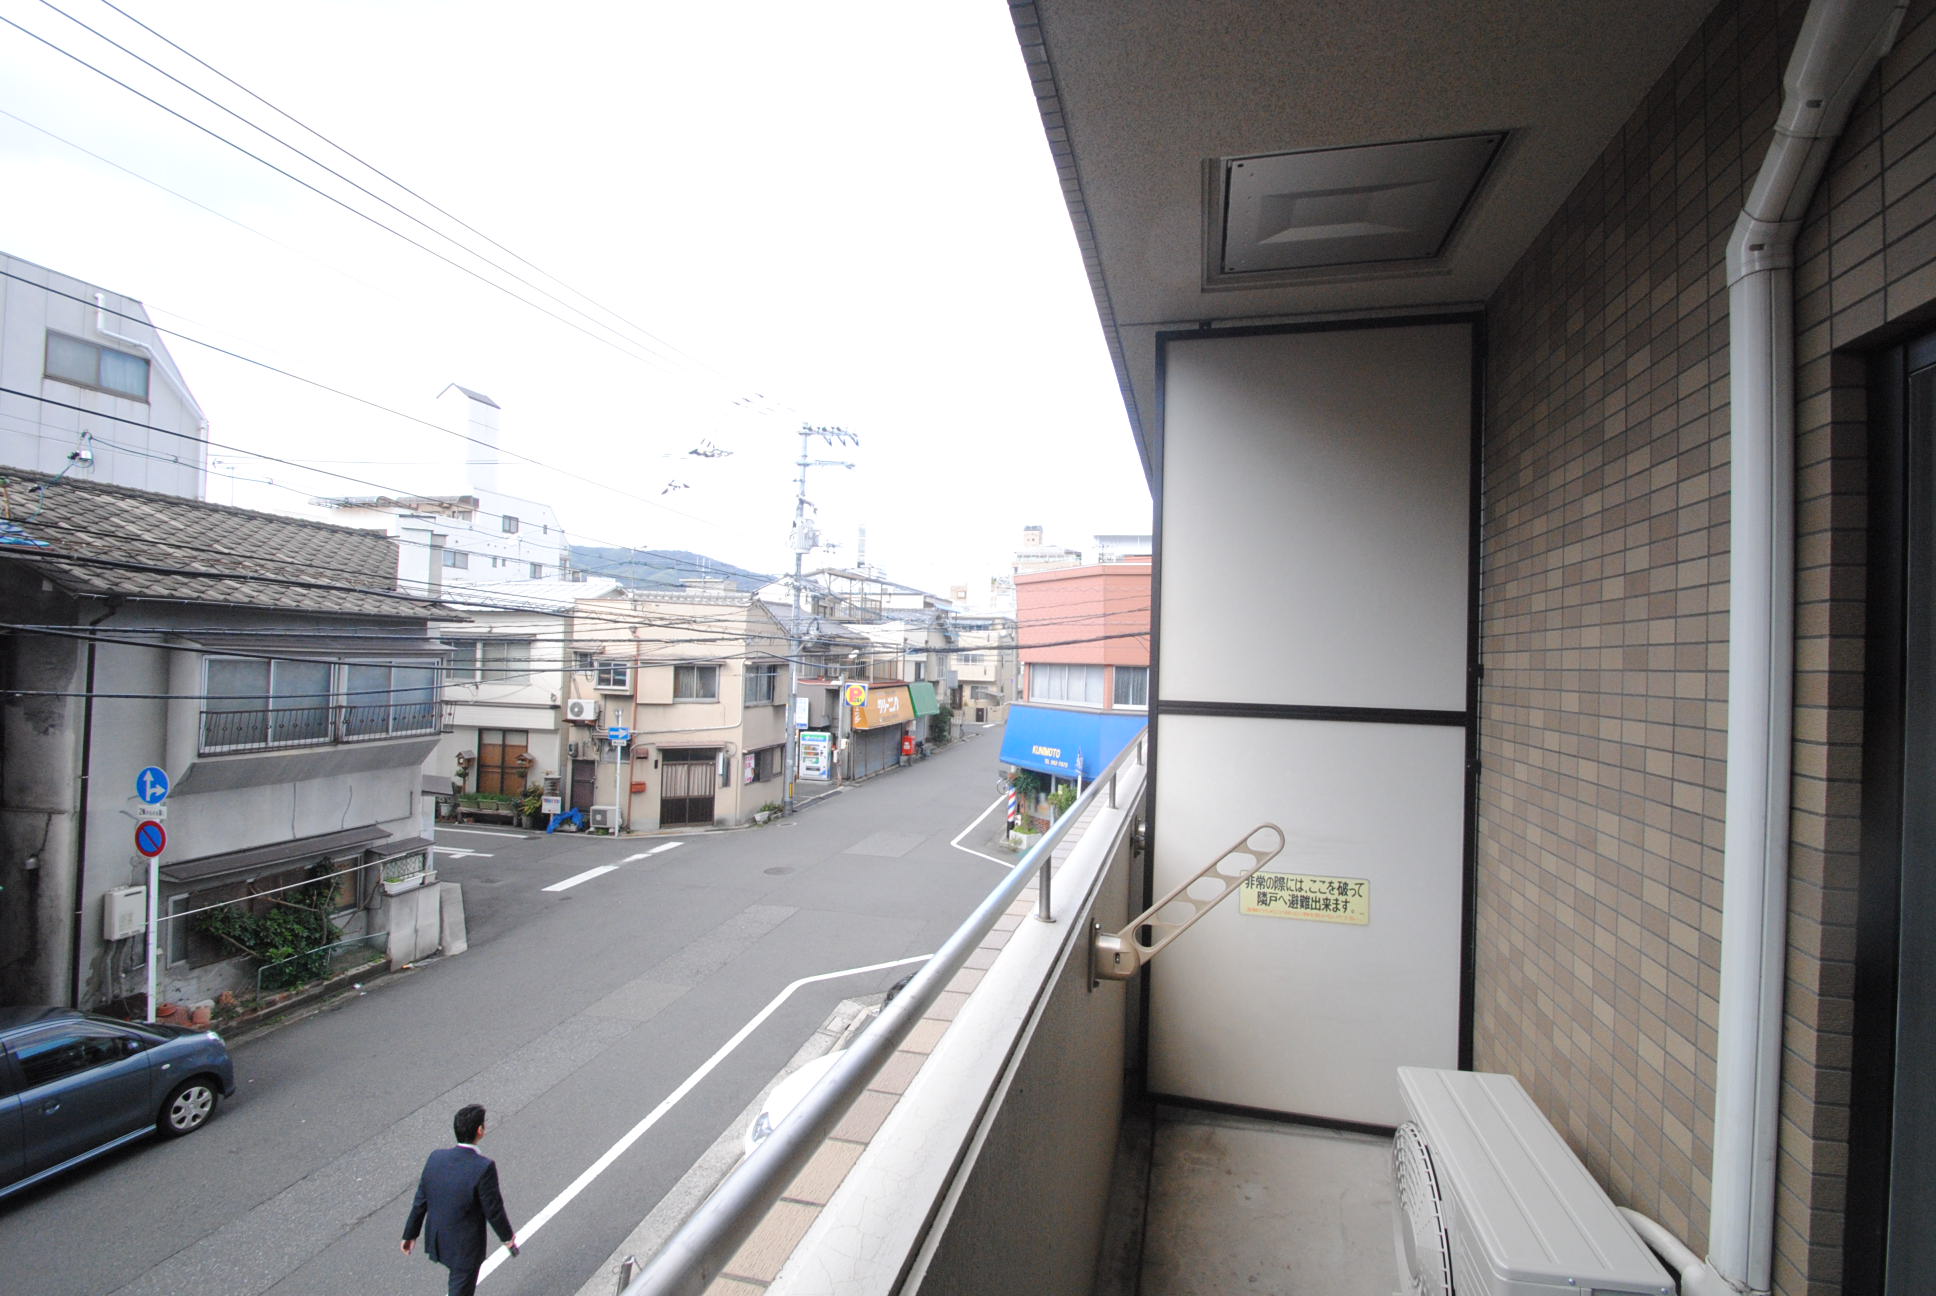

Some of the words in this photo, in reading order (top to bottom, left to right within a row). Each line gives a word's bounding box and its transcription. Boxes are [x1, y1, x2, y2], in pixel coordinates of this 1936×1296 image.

[849, 687, 863, 703] P
[1257, 891, 1354, 914] 隣戸へ避難出来ます。
